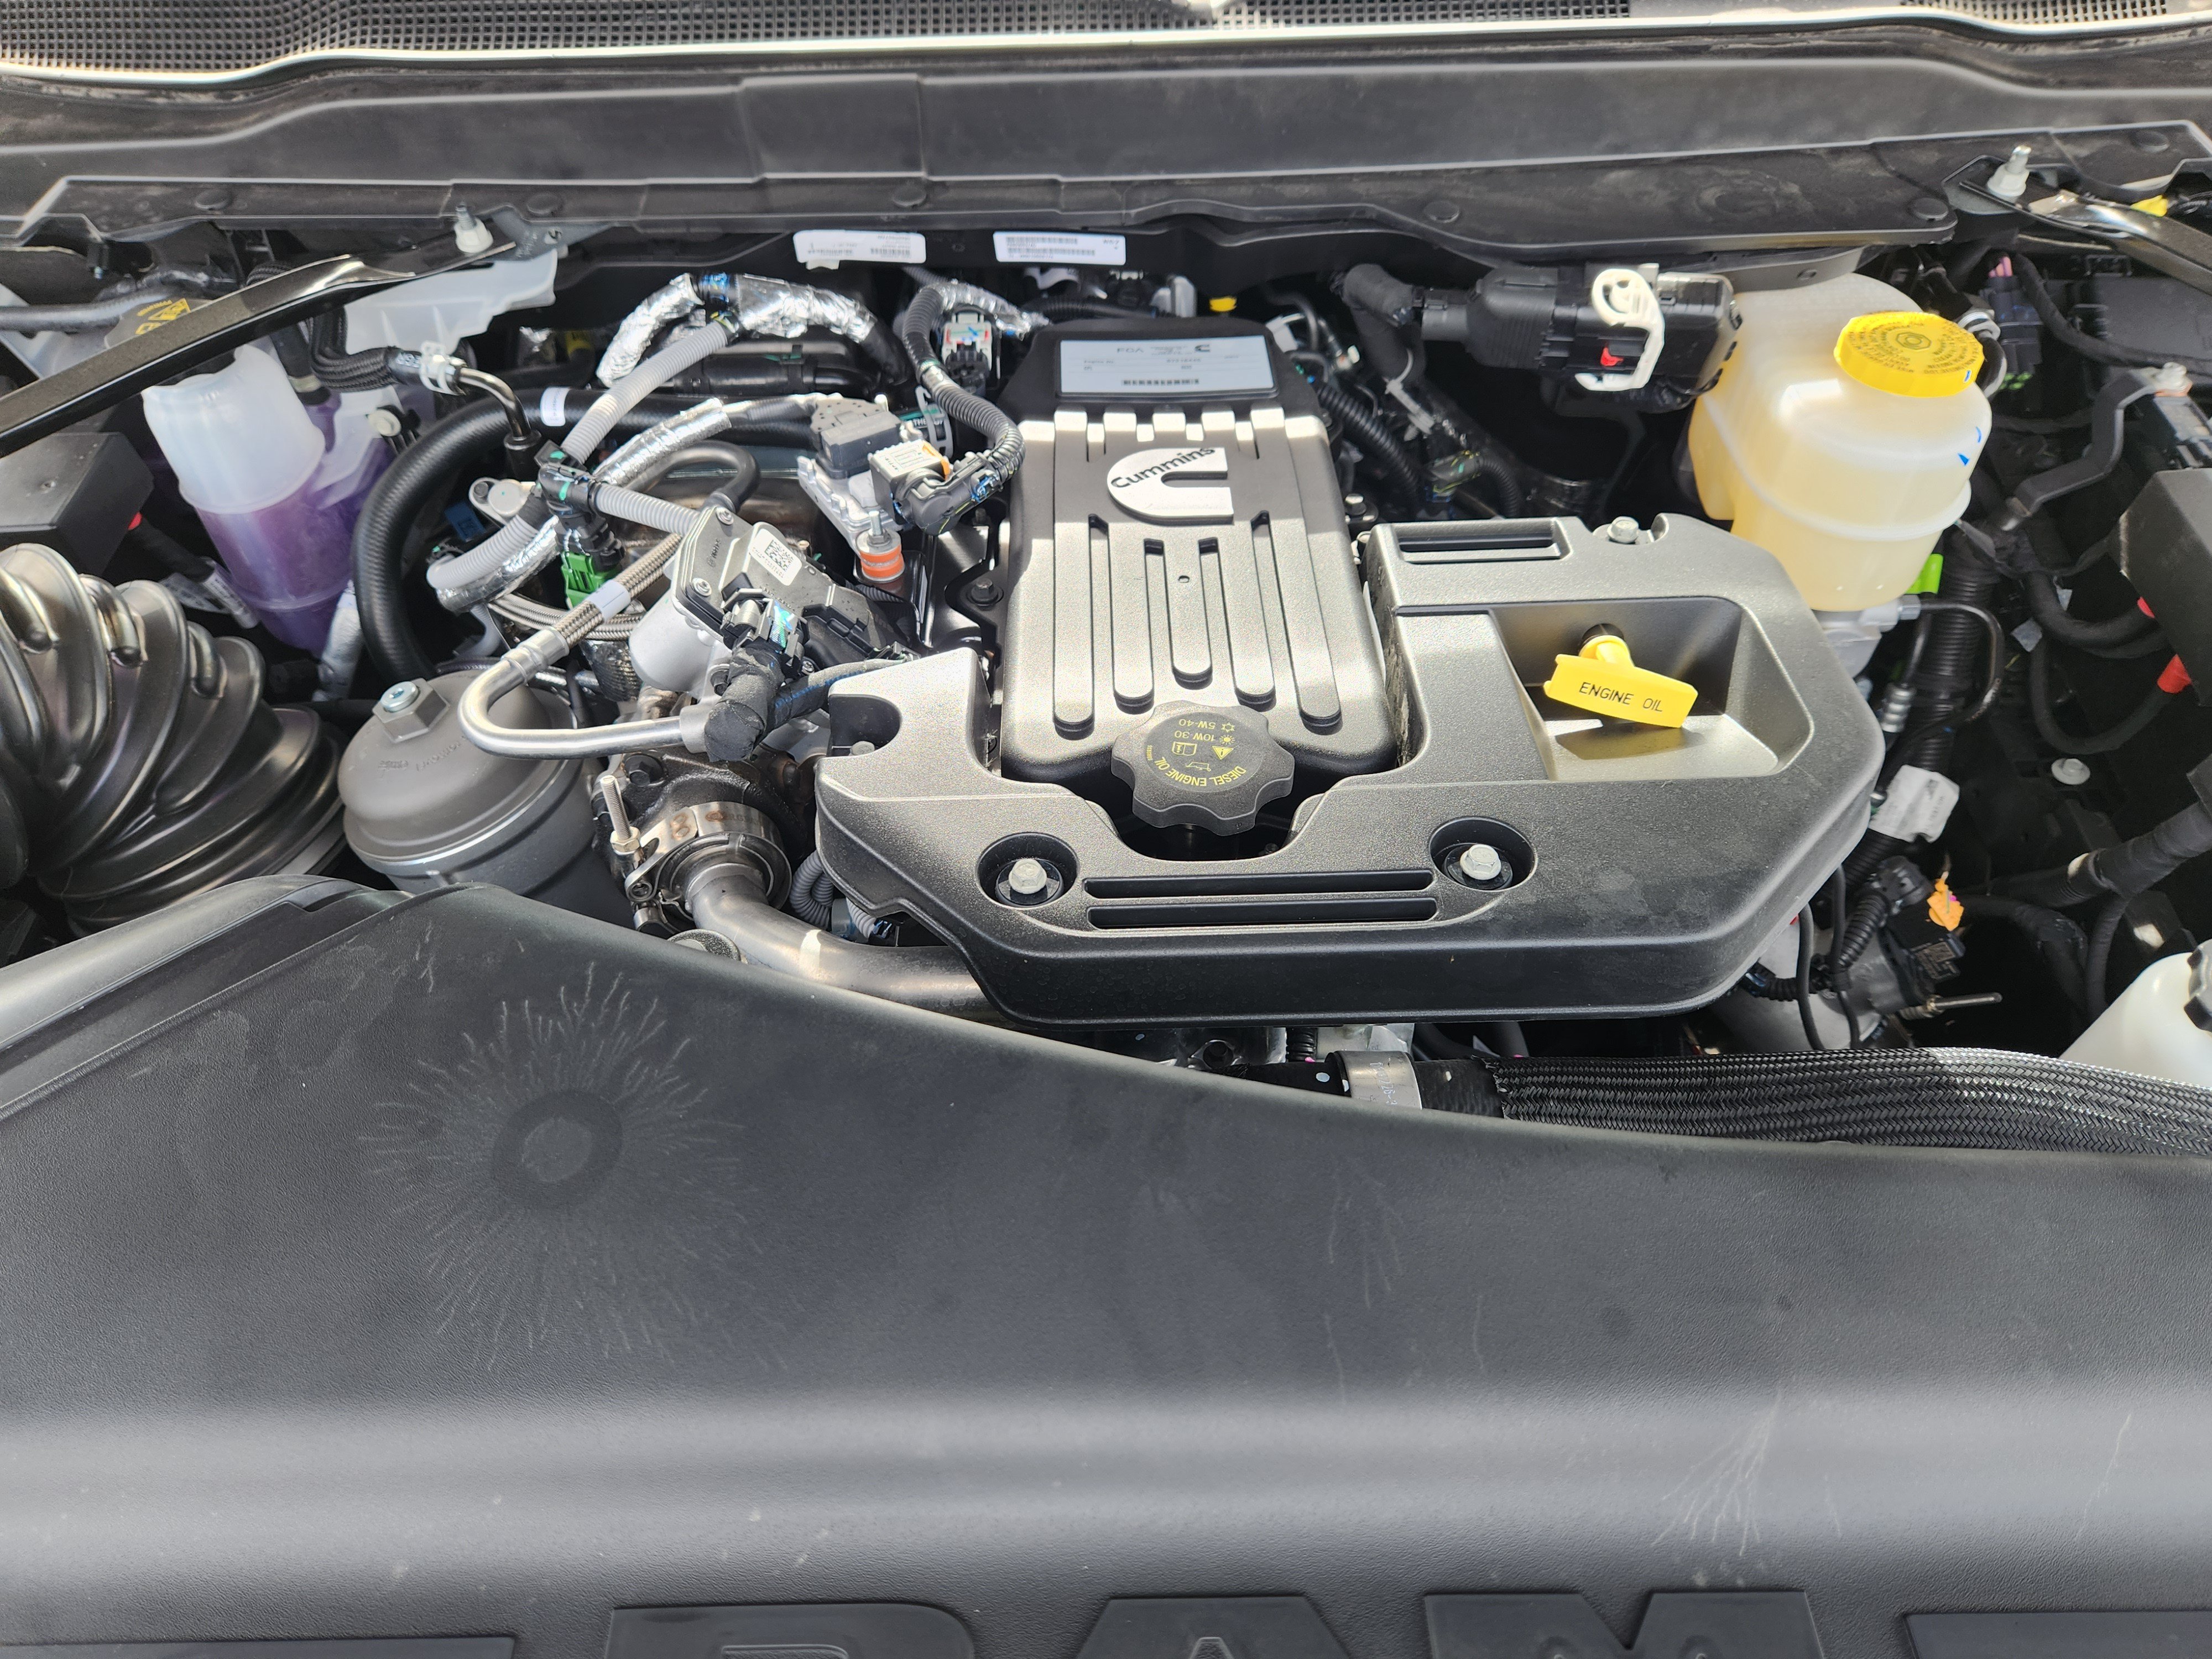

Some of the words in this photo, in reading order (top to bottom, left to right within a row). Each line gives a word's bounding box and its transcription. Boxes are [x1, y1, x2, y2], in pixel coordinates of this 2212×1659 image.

[1110, 446, 1215, 488] Cummins
[1578, 682, 1634, 705] ENGINE
[1642, 698, 1663, 712] OIL
[1178, 718, 1216, 729] 5W-40
[1154, 756, 1171, 771] OIL
[1165, 768, 1207, 786] ENGINE
[1209, 765, 1247, 786] DIESEL
